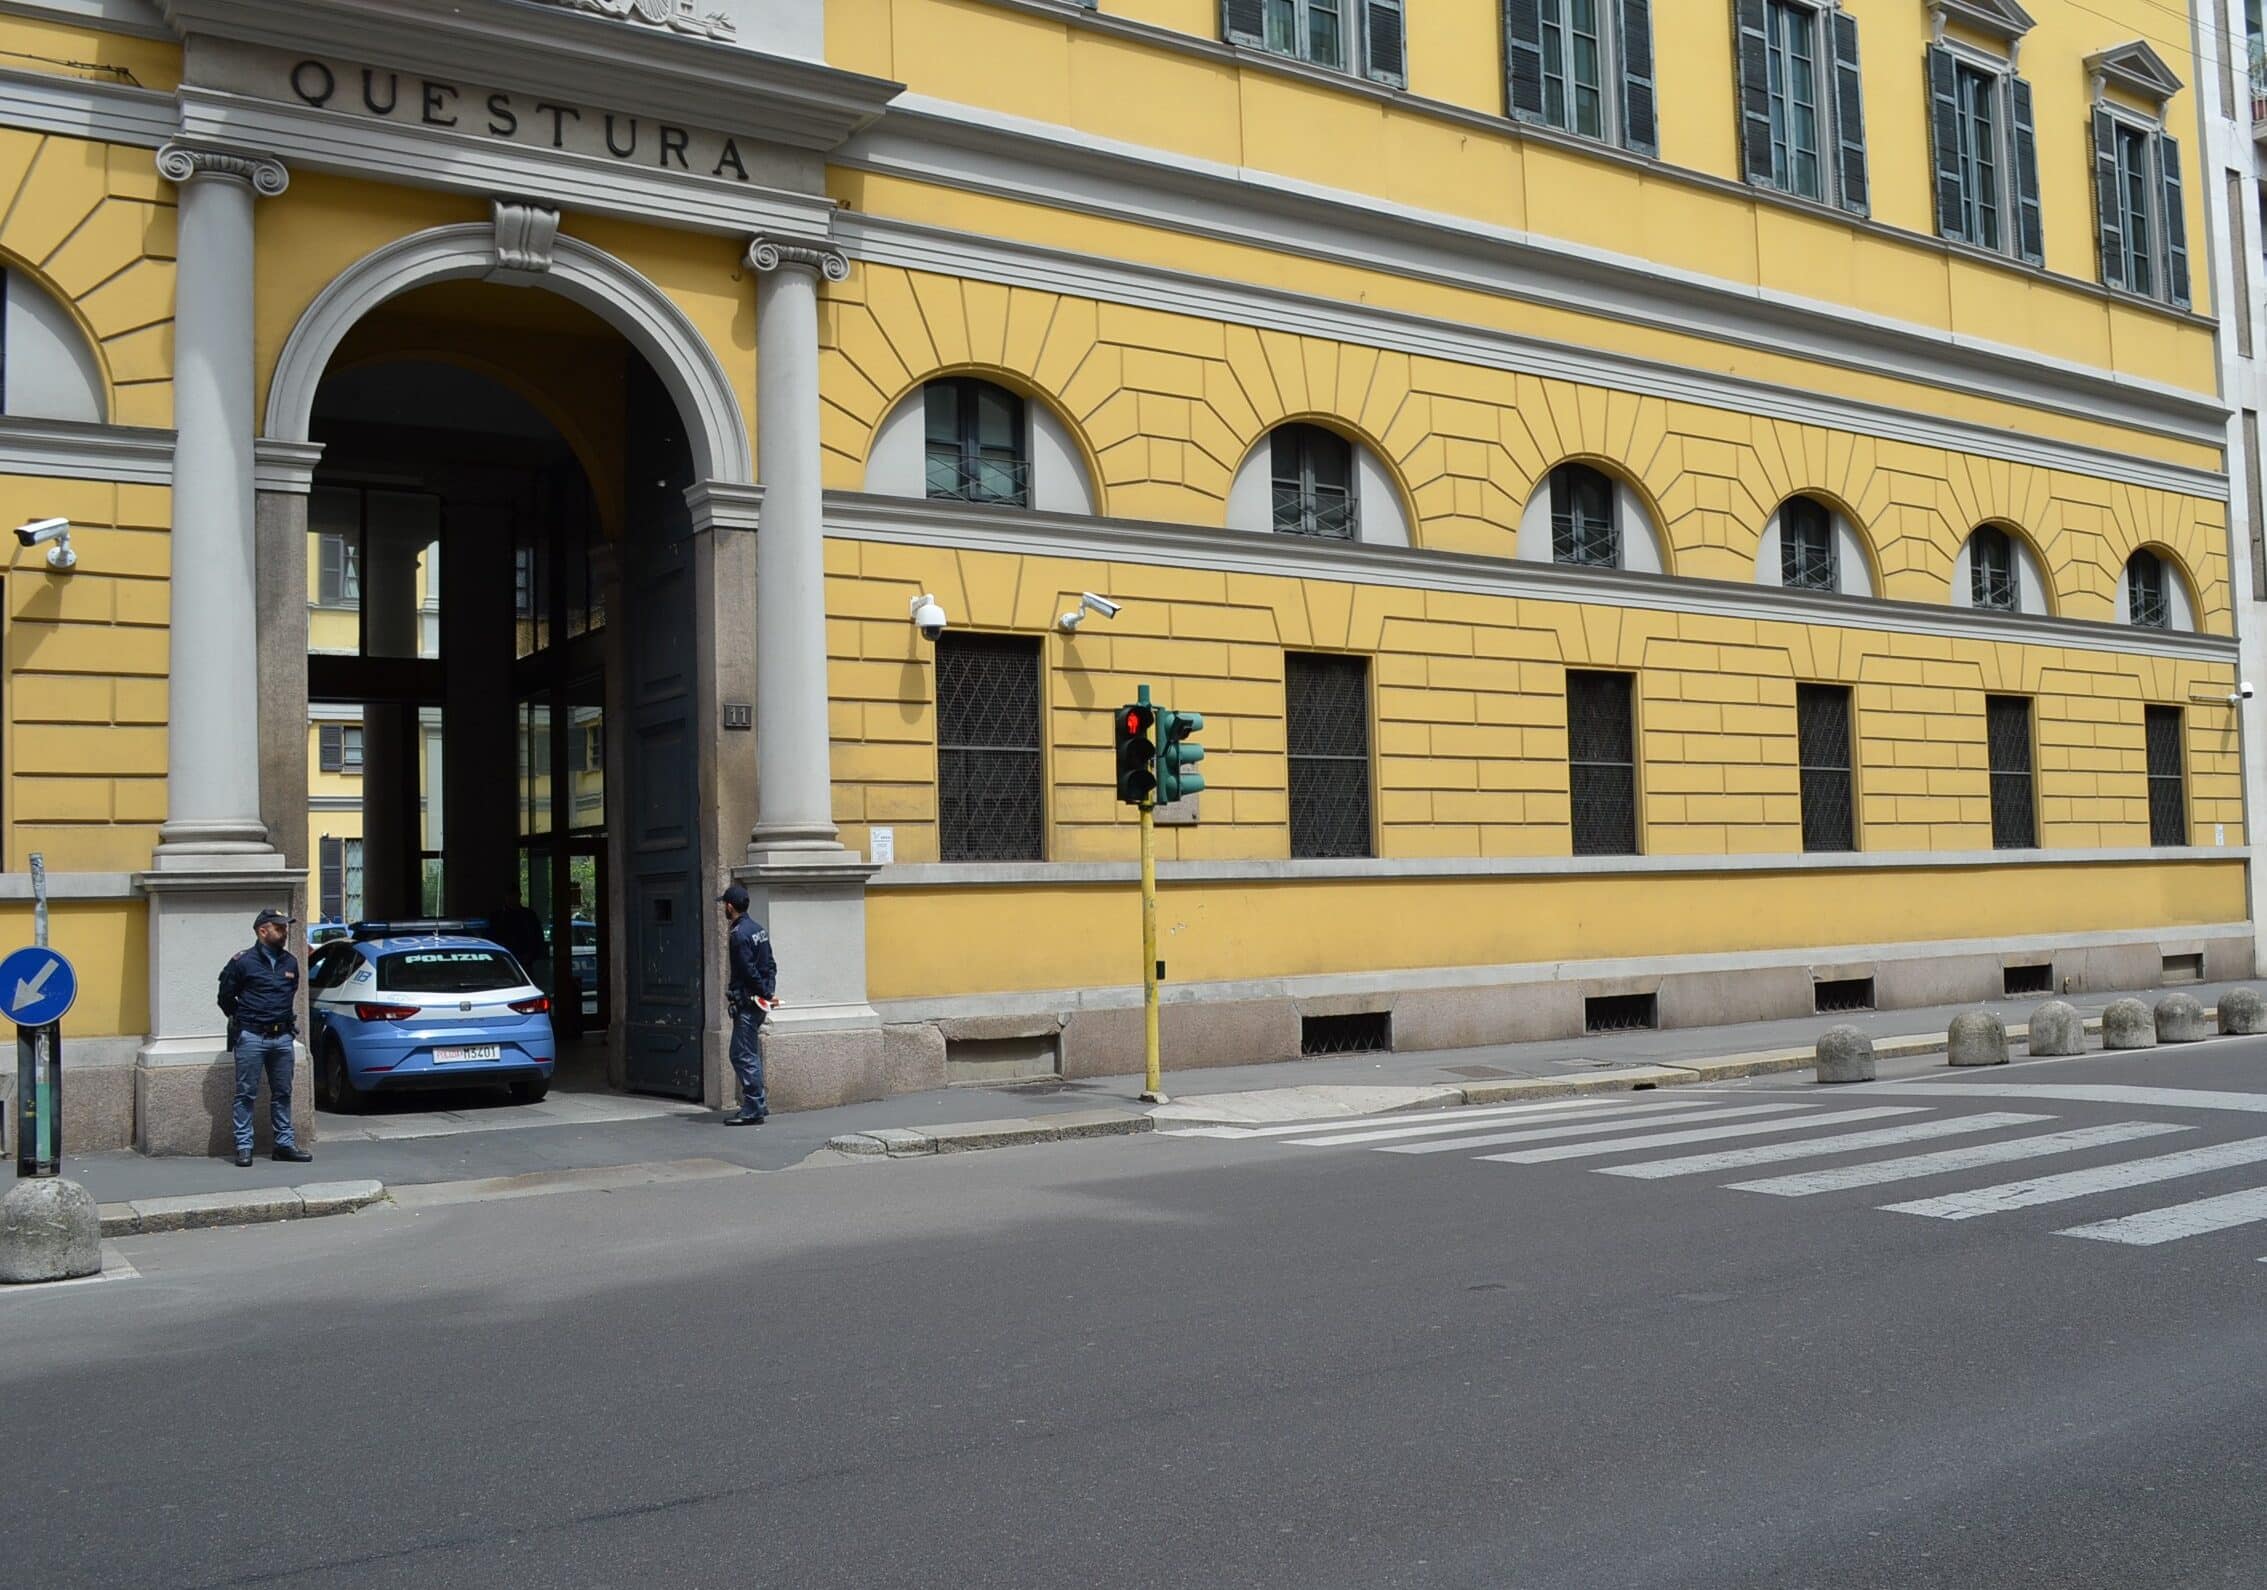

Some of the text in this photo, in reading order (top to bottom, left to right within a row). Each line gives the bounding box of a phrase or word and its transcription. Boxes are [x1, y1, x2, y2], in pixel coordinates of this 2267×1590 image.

[290, 60, 749, 180] QUESTURA
[730, 706, 746, 723] 11
[405, 953, 494, 963] POLIZIA
